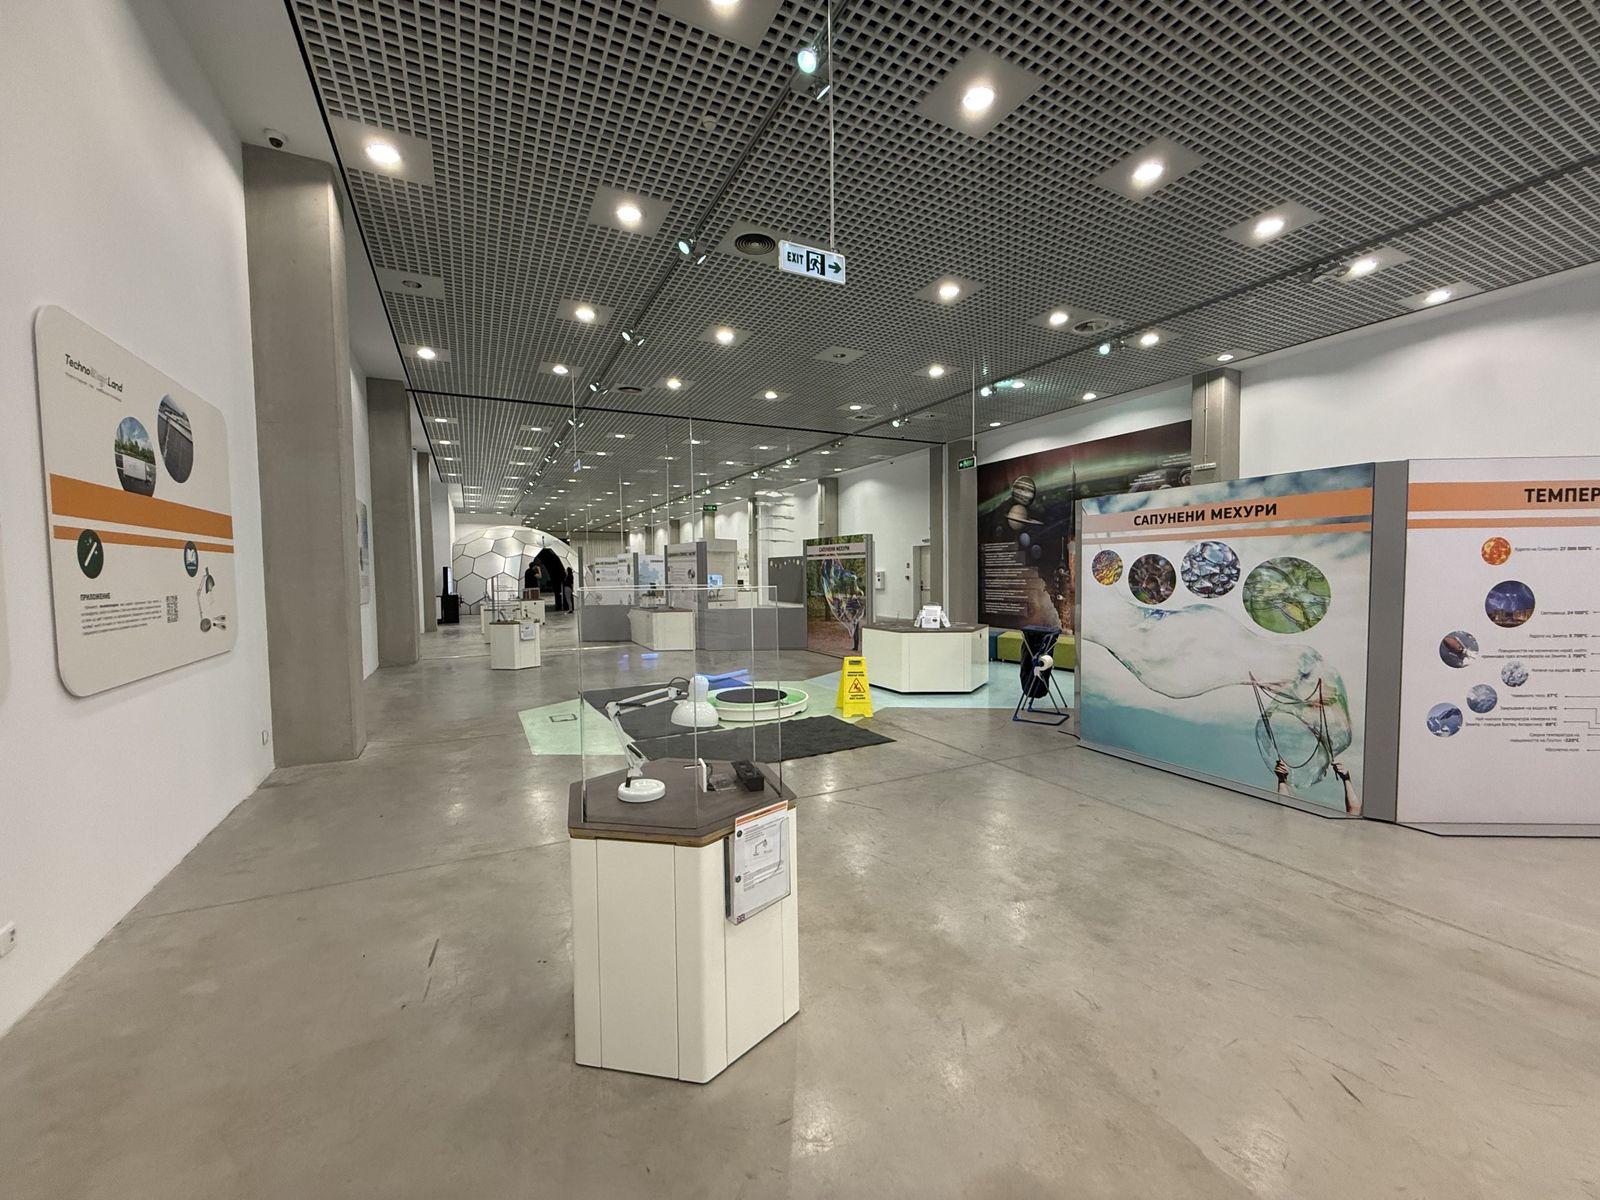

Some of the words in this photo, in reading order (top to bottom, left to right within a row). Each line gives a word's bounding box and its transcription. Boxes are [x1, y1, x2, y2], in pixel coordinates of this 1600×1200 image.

[787, 251, 804, 264] EXIT
[1524, 487, 1600, 503] ТЕМПЕР
[1134, 509, 1205, 526] САПУНЕНИ
[1210, 503, 1277, 520] МЕХУРИ
